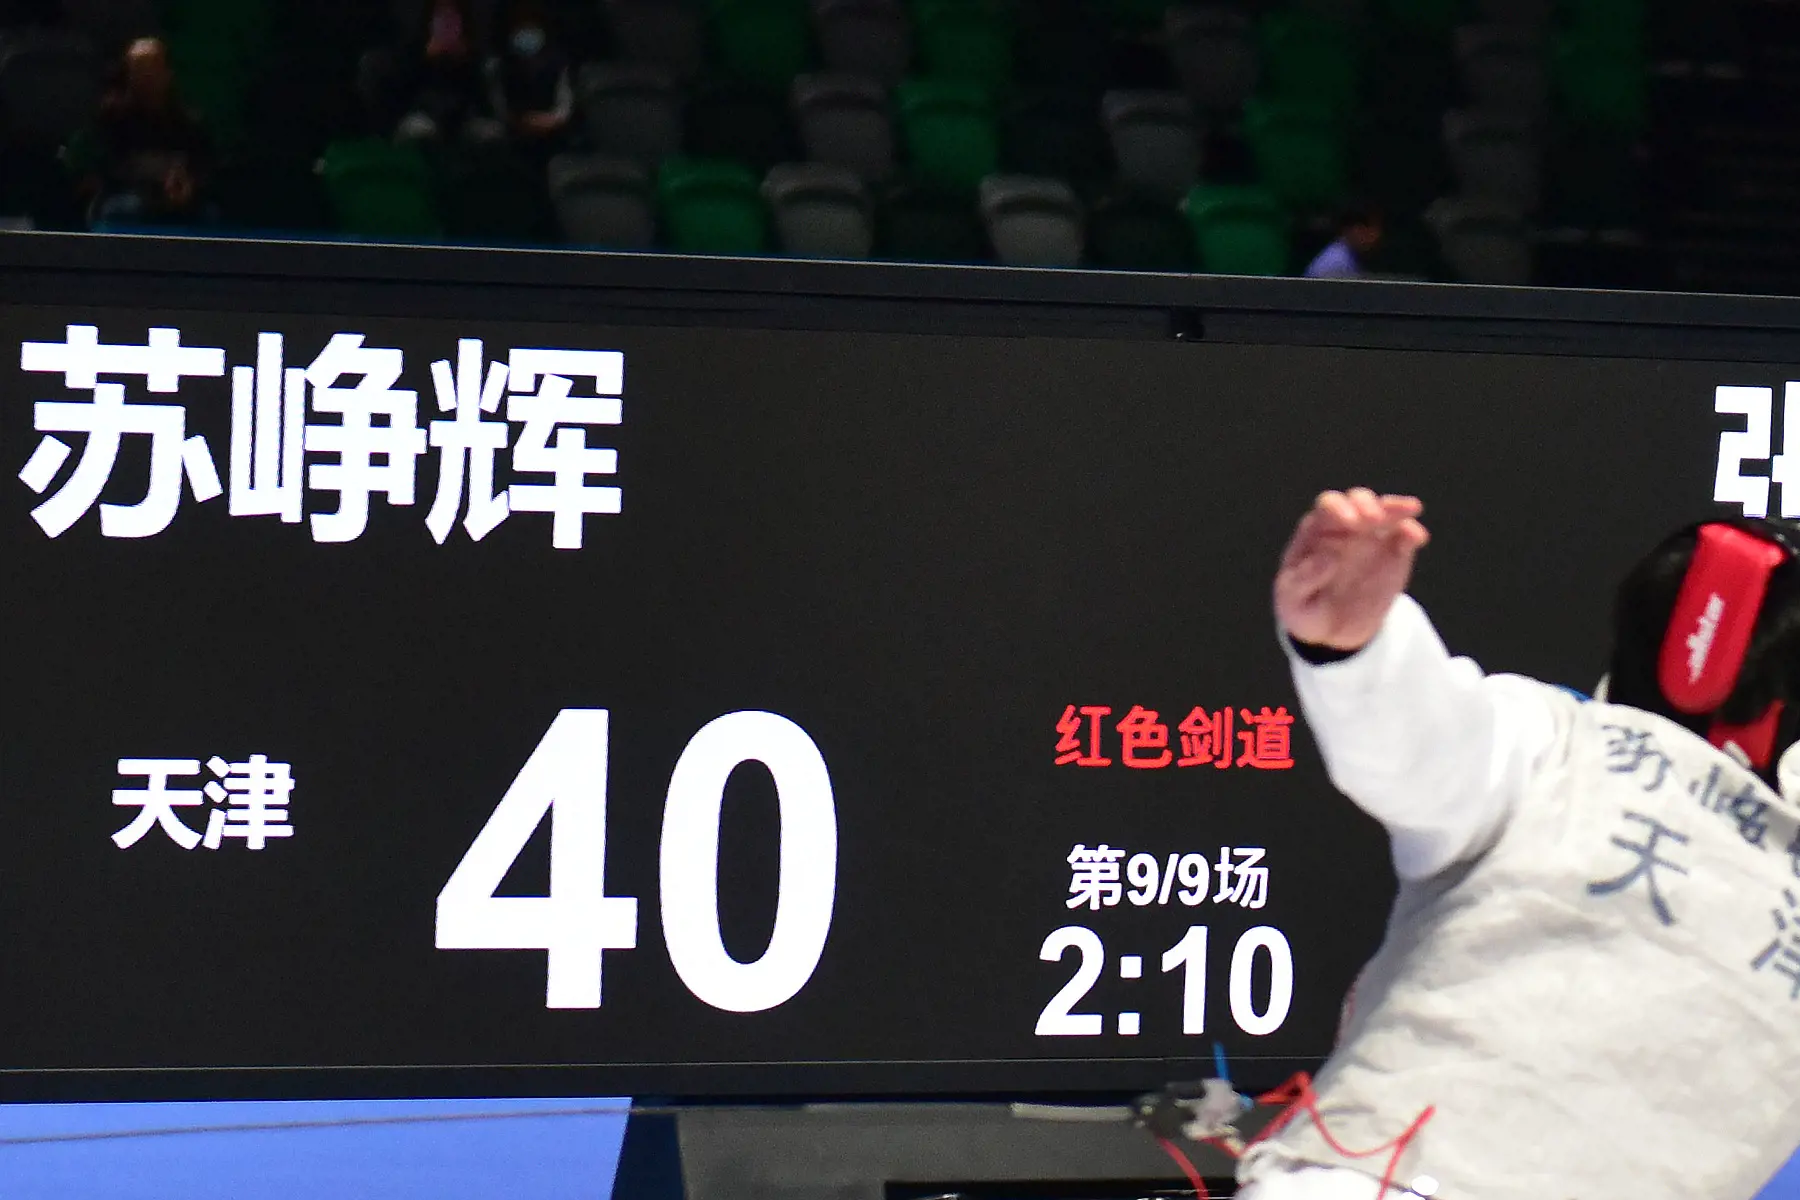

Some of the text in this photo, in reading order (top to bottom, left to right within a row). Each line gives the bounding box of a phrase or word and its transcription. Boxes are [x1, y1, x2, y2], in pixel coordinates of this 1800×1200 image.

[19, 325, 624, 549] 苏峥辉
[1055, 705, 1295, 770] 红色剑道
[111, 755, 296, 850] 天津
[434, 709, 838, 1013] 40
[1066, 844, 1269, 910] 第9/9场
[1034, 925, 1293, 1036] 2:10
